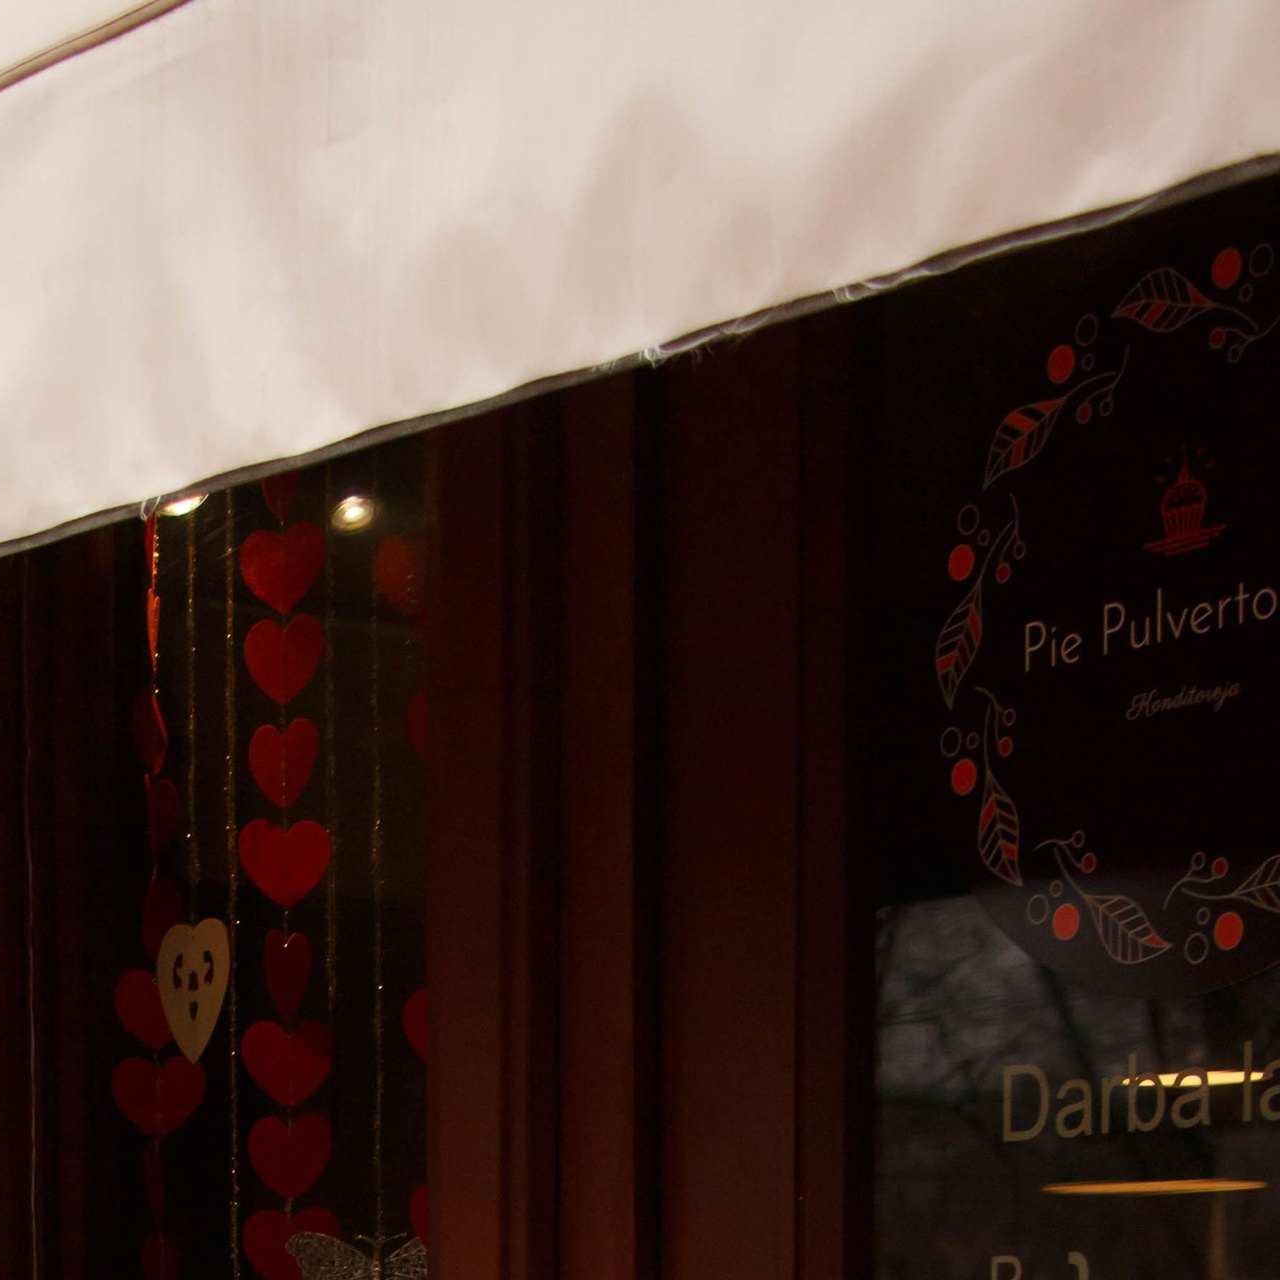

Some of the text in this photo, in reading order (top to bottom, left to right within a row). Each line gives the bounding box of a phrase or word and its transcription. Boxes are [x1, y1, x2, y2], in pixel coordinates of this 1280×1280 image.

[1024, 582, 1278, 673] Pie Pulverto
[1002, 1052, 1211, 1143] Darba
